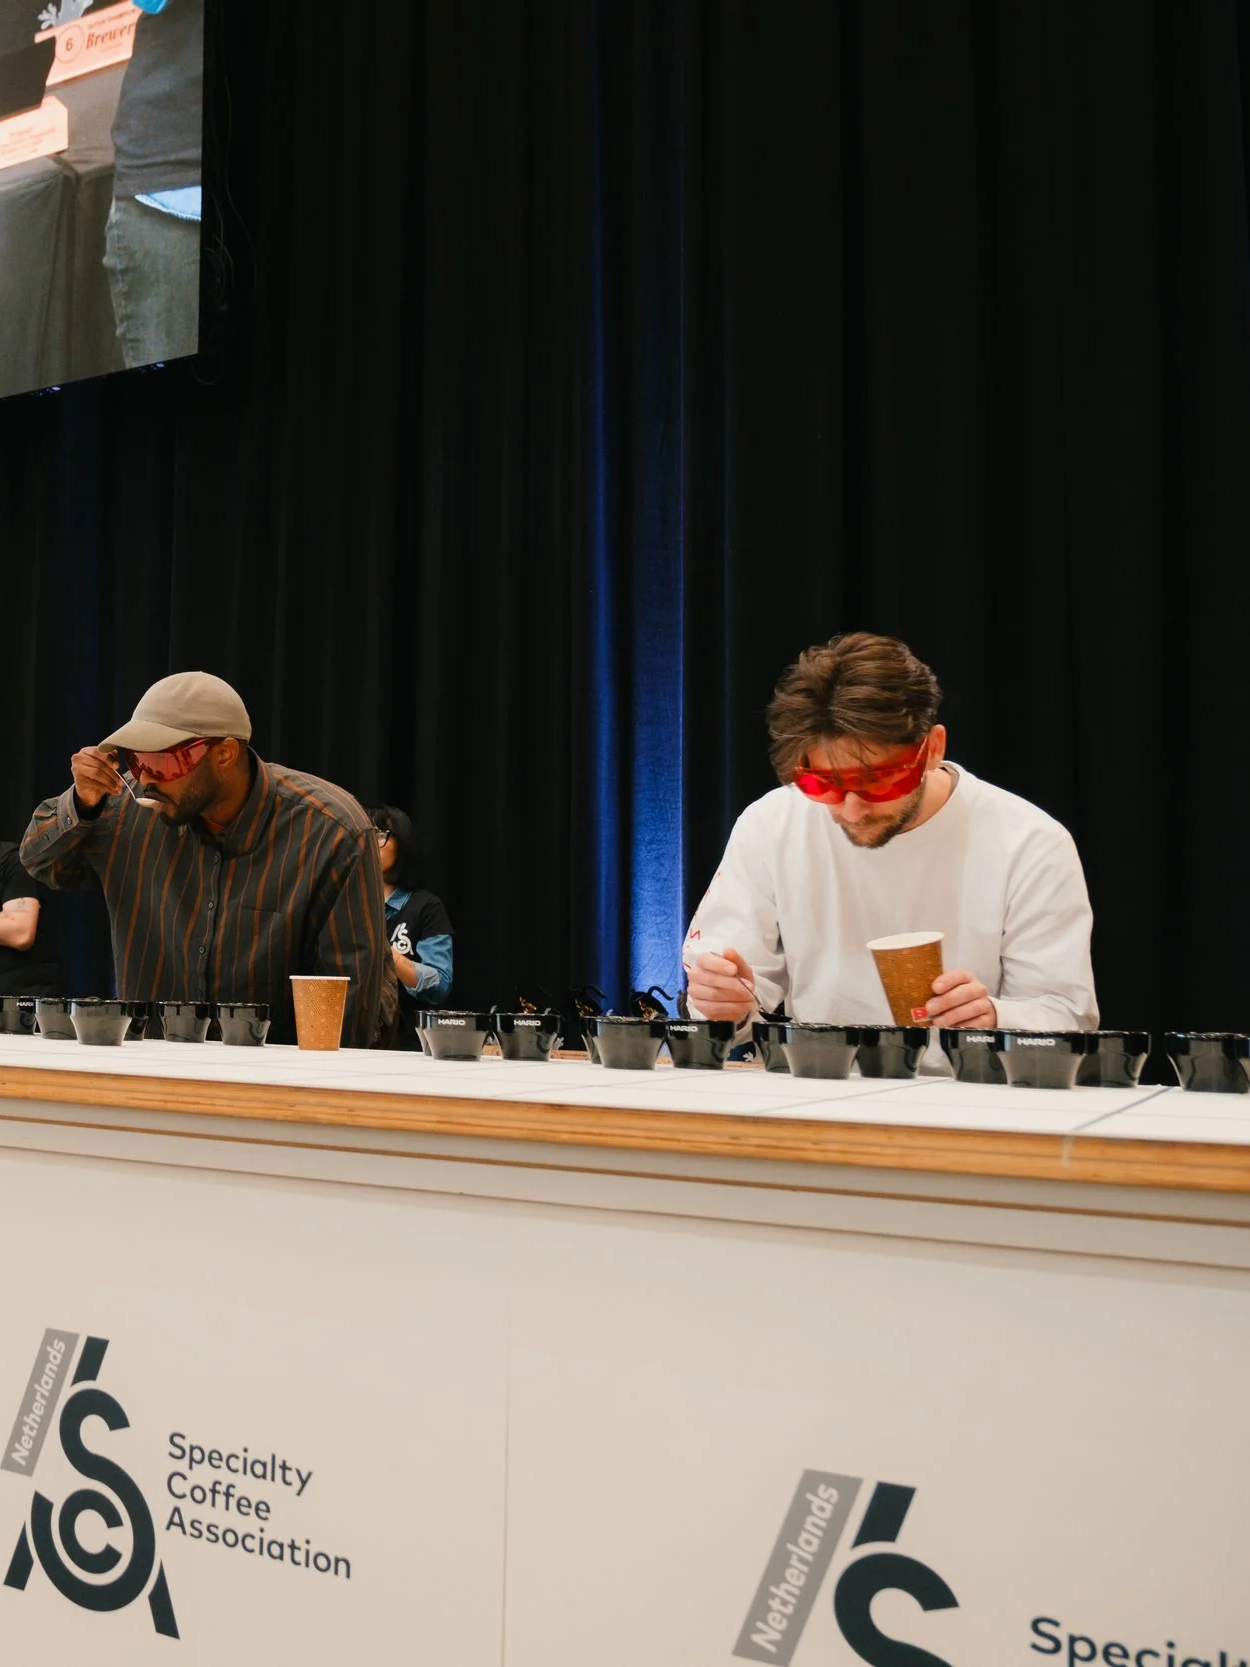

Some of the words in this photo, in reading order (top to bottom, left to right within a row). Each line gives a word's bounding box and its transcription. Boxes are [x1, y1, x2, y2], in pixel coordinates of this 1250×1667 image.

[438, 1018, 466, 1026] HARIO
[513, 1019, 542, 1027] HARIO
[1017, 1038, 1056, 1046] HARIO
[10, 1337, 67, 1466] Netherlands
[168, 1432, 313, 1496] Specialty
[166, 1471, 272, 1522] Coffee
[165, 1506, 352, 1580] Association
[749, 1481, 840, 1654] Netherlands
